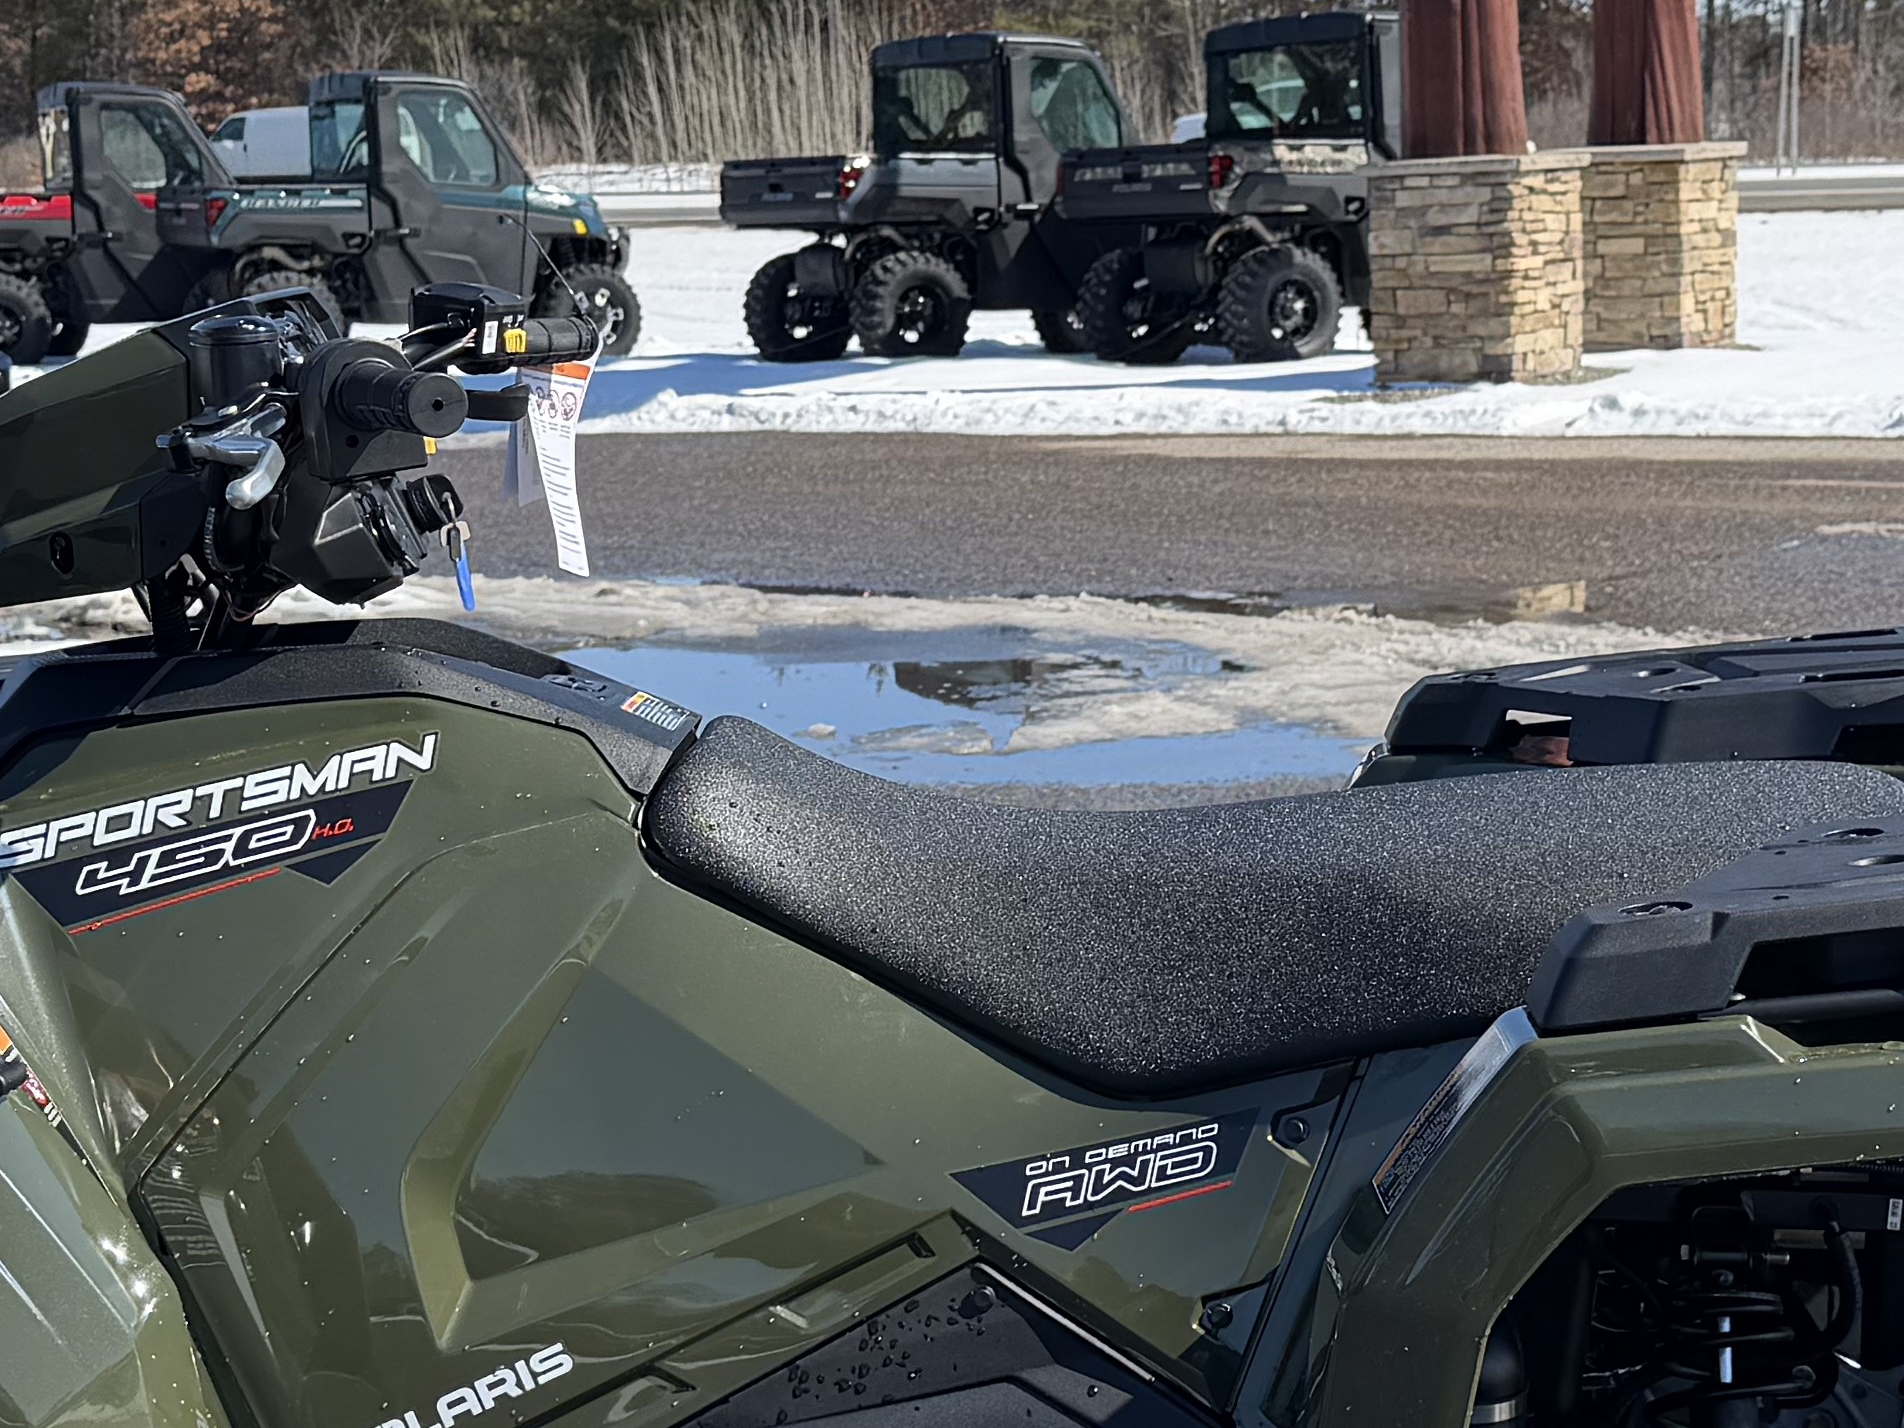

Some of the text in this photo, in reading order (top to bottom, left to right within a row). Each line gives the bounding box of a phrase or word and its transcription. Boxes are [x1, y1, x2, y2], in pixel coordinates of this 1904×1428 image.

[74, 808, 317, 897] 450
[1021, 1141, 1218, 1216] AWD
[1025, 1124, 1219, 1175] ON DEMAND
